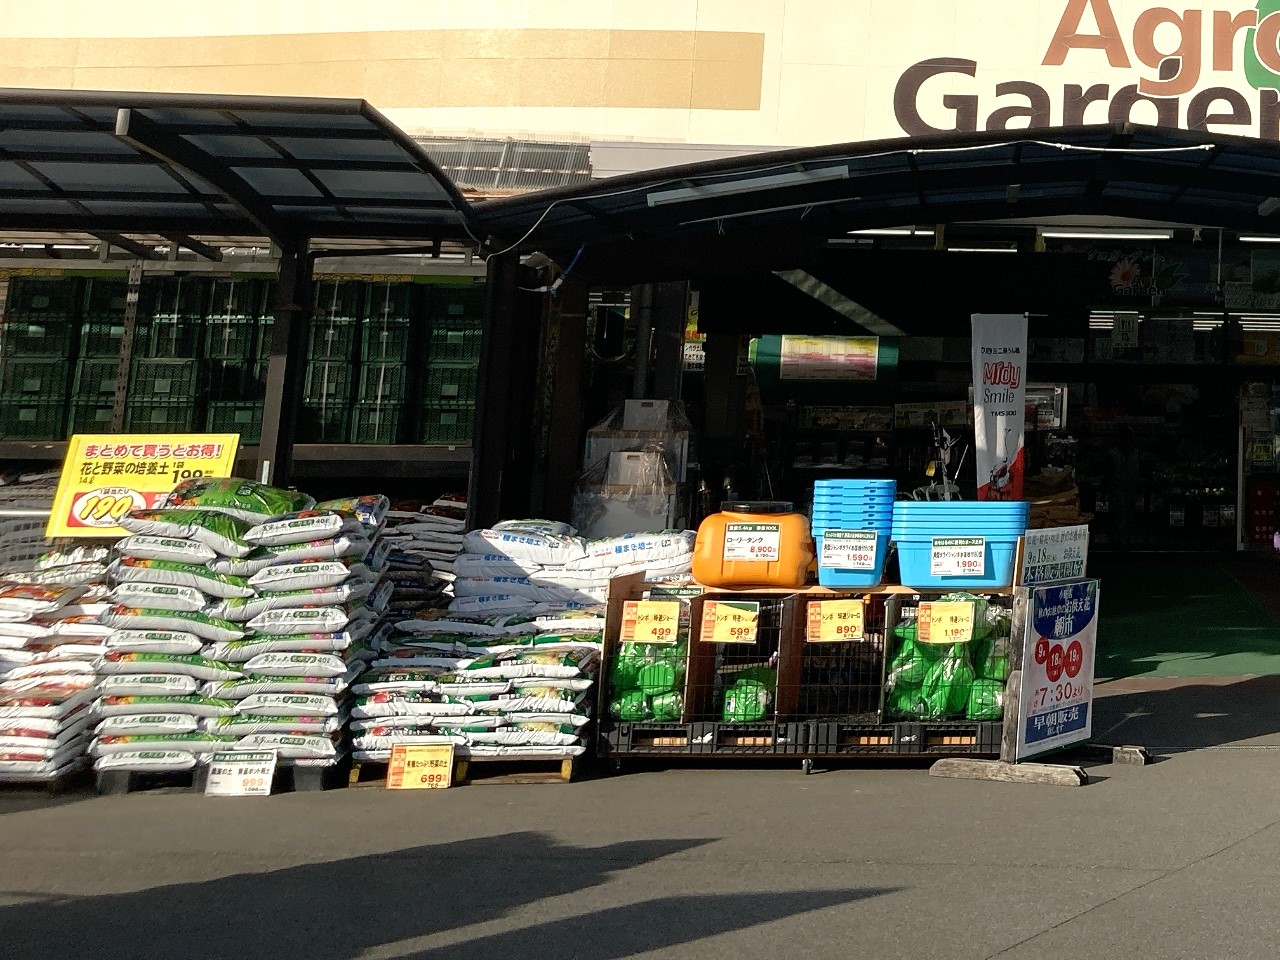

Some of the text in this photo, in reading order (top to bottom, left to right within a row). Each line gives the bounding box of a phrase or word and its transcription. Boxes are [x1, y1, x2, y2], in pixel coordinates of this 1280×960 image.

[983, 361, 1021, 389] Midy
[984, 388, 1015, 403] Smile
[85, 444, 222, 459] まとめて買うとお得!
[80, 462, 169, 475] 花と野菜の培養土
[1054, 614, 1075, 637] 朝市
[1033, 707, 1079, 730] 早朝販売
[420, 774, 442, 783] 699
